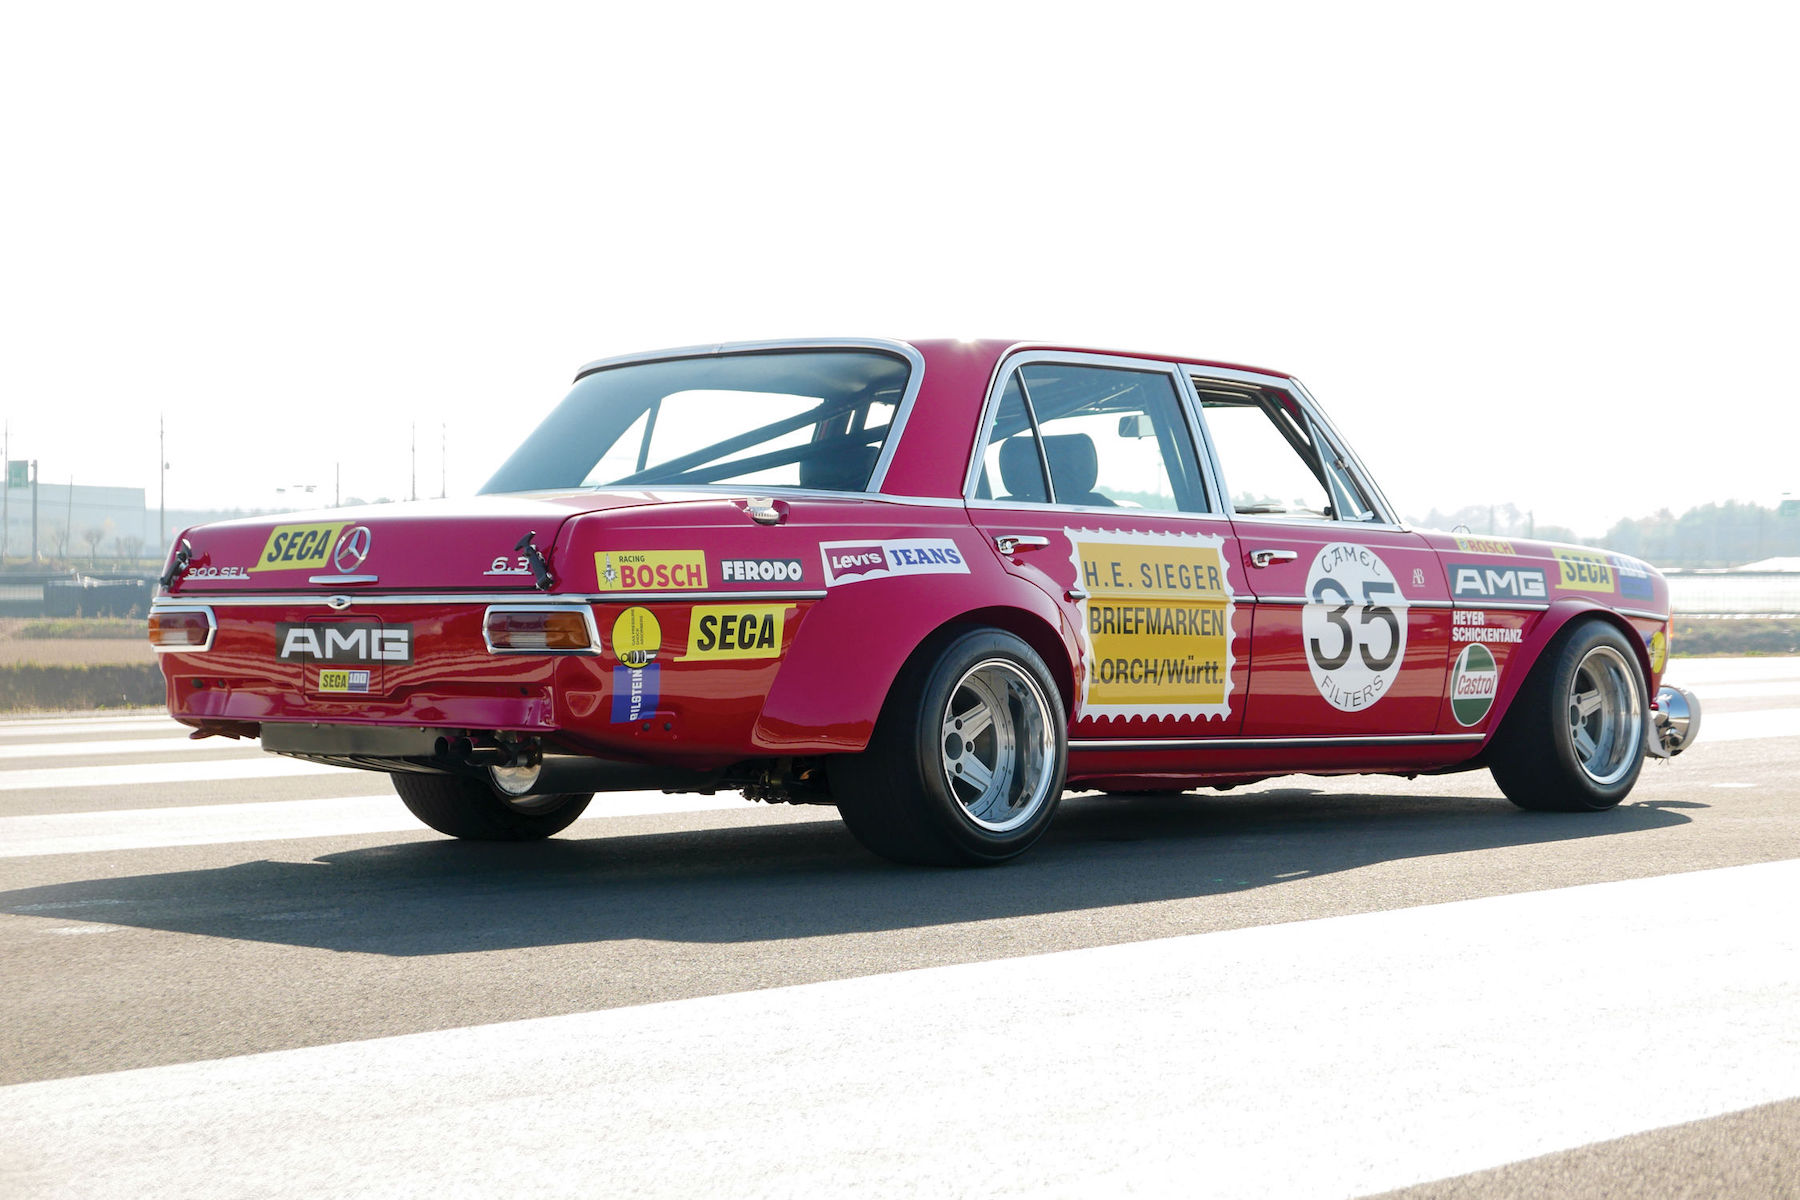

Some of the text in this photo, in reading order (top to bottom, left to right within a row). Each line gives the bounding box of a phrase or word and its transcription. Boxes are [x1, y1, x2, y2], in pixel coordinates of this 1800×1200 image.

[267, 529, 332, 562] SECA
[619, 555, 646, 563] RACING
[889, 548, 962, 566] JEANS
[1467, 539, 1513, 554] BOSCH
[187, 566, 248, 577] 300 SEL
[491, 556, 530, 571] 6.3
[721, 560, 803, 581] FERODO
[1321, 546, 1381, 576] CAMEL
[1561, 554, 1610, 584] SECA
[620, 564, 703, 588] BOSCH
[1083, 561, 1221, 591] H.E. SIEGER
[1455, 568, 1547, 597] AMG
[1089, 606, 1224, 637] BRIEFMARKEN
[1310, 577, 1401, 672] 35
[1453, 610, 1485, 626] HEYER
[280, 628, 409, 660] AMG
[697, 614, 775, 652] SECA
[1452, 627, 1523, 643] SCHICKENTANZ
[322, 674, 347, 688] SECA
[1090, 655, 1224, 686] LORCH/Württ.
[1457, 674, 1496, 695] Castrol
[629, 669, 643, 721] BILSTEIN
[1321, 674, 1384, 708] FILTERS
